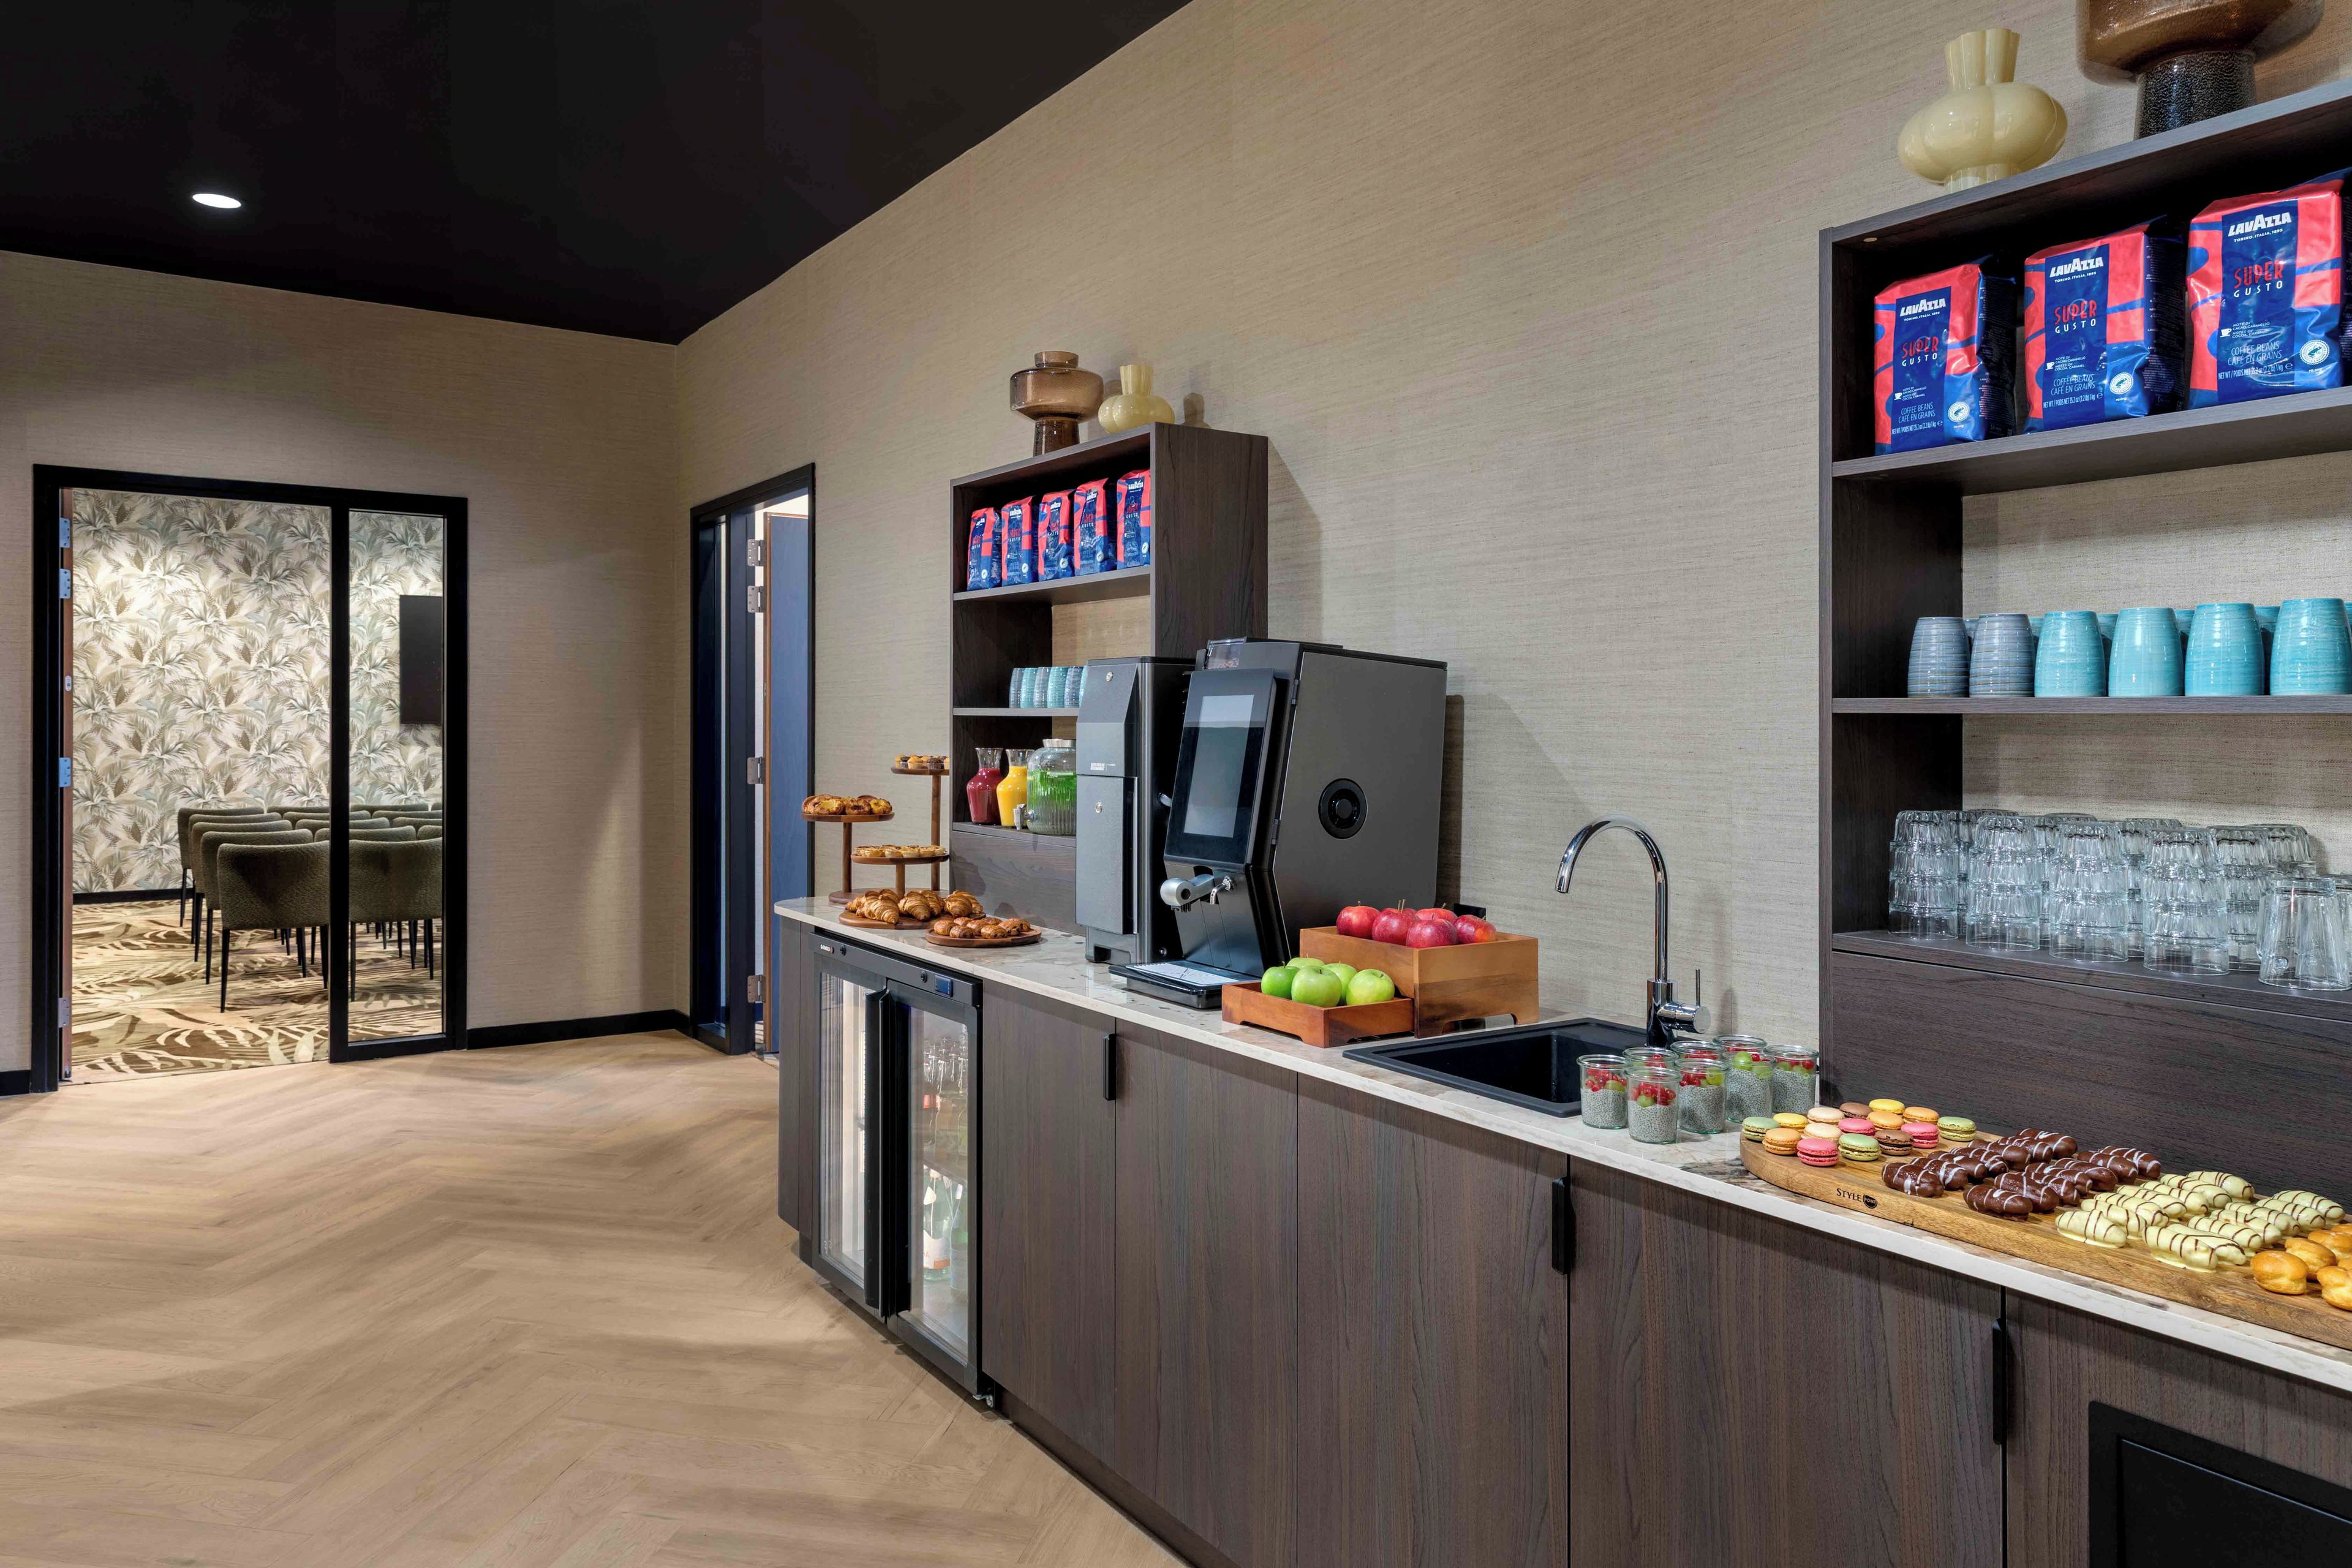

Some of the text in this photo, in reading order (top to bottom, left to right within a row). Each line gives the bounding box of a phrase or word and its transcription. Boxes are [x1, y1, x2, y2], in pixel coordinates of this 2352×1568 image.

[2228, 212, 2292, 236] LAVAZZA
[2049, 257, 2103, 277] LAVAZZA
[2234, 260, 2284, 288] SUPER
[2234, 281, 2283, 298] GUSTO
[1900, 298, 1946, 317] LAVAZZA
[2054, 300, 2097, 325] SUPER
[2055, 318, 2096, 333] GUSTO
[1902, 336, 1939, 359] SUPER
[2231, 341, 2280, 356] COFFEE BEANS
[1902, 353, 1937, 367] GUSTO
[2228, 350, 2282, 366] CAFÉ EN GRAINS
[2054, 374, 2094, 386] COFFEE BEANS
[2051, 385, 2064, 396] CAFÉ
[2075, 382, 2095, 392] GRAINS
[1901, 402, 1934, 415] COFFEE BEANS
[1899, 413, 1910, 423] CAFÉ
[1918, 410, 1936, 420] GRAINS
[1836, 1188, 1861, 1202] STYLE
